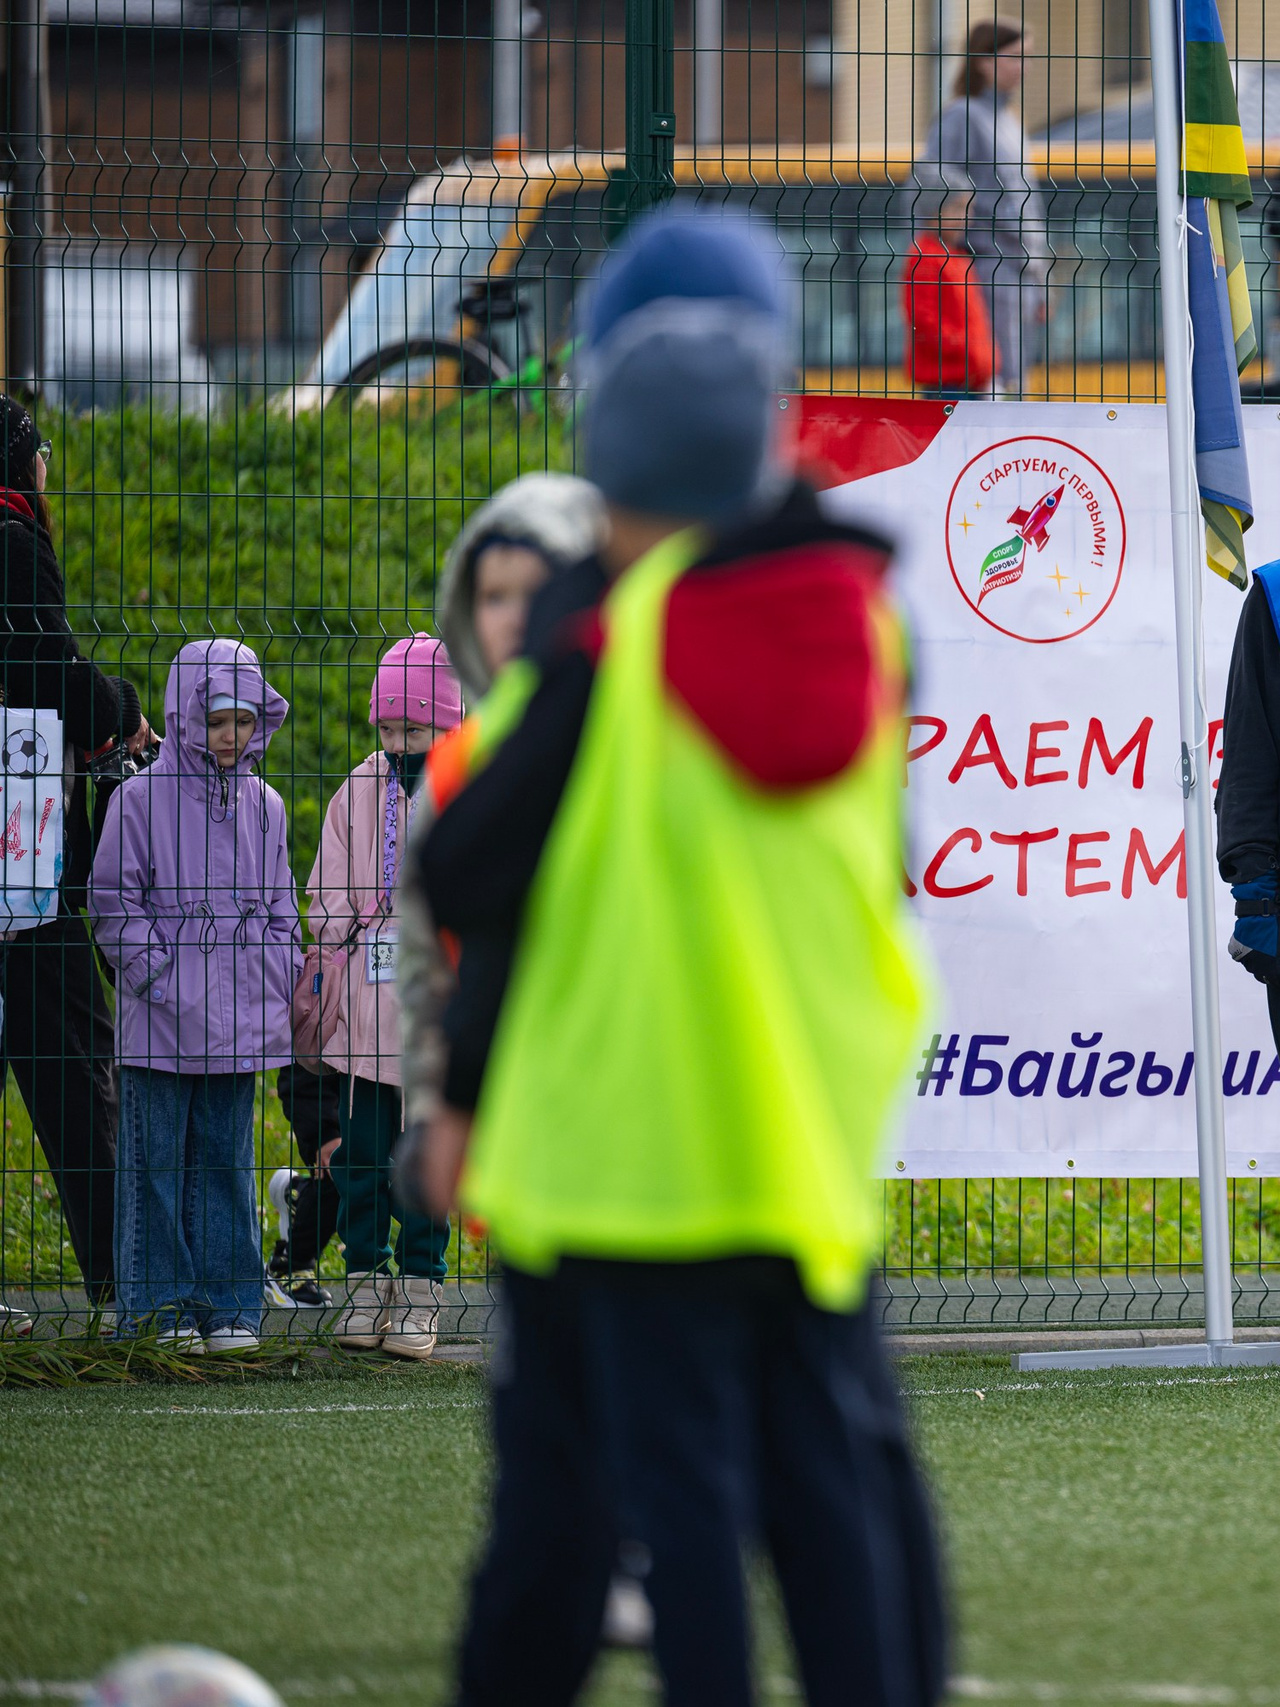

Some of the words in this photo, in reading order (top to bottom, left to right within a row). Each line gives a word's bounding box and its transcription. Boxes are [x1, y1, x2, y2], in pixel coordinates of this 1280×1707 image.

[979, 458, 1057, 492] СТАРТУЕМ
[1058, 466, 1069, 480] С
[992, 544, 1014, 559] СПОРТ
[984, 557, 1019, 576] ЗДОРОВЬЕ
[981, 570, 1022, 593] ПАТРИОТИЗМ
[901, 713, 1153, 790] РАЕМ
[902, 827, 1187, 899] СТЕМ
